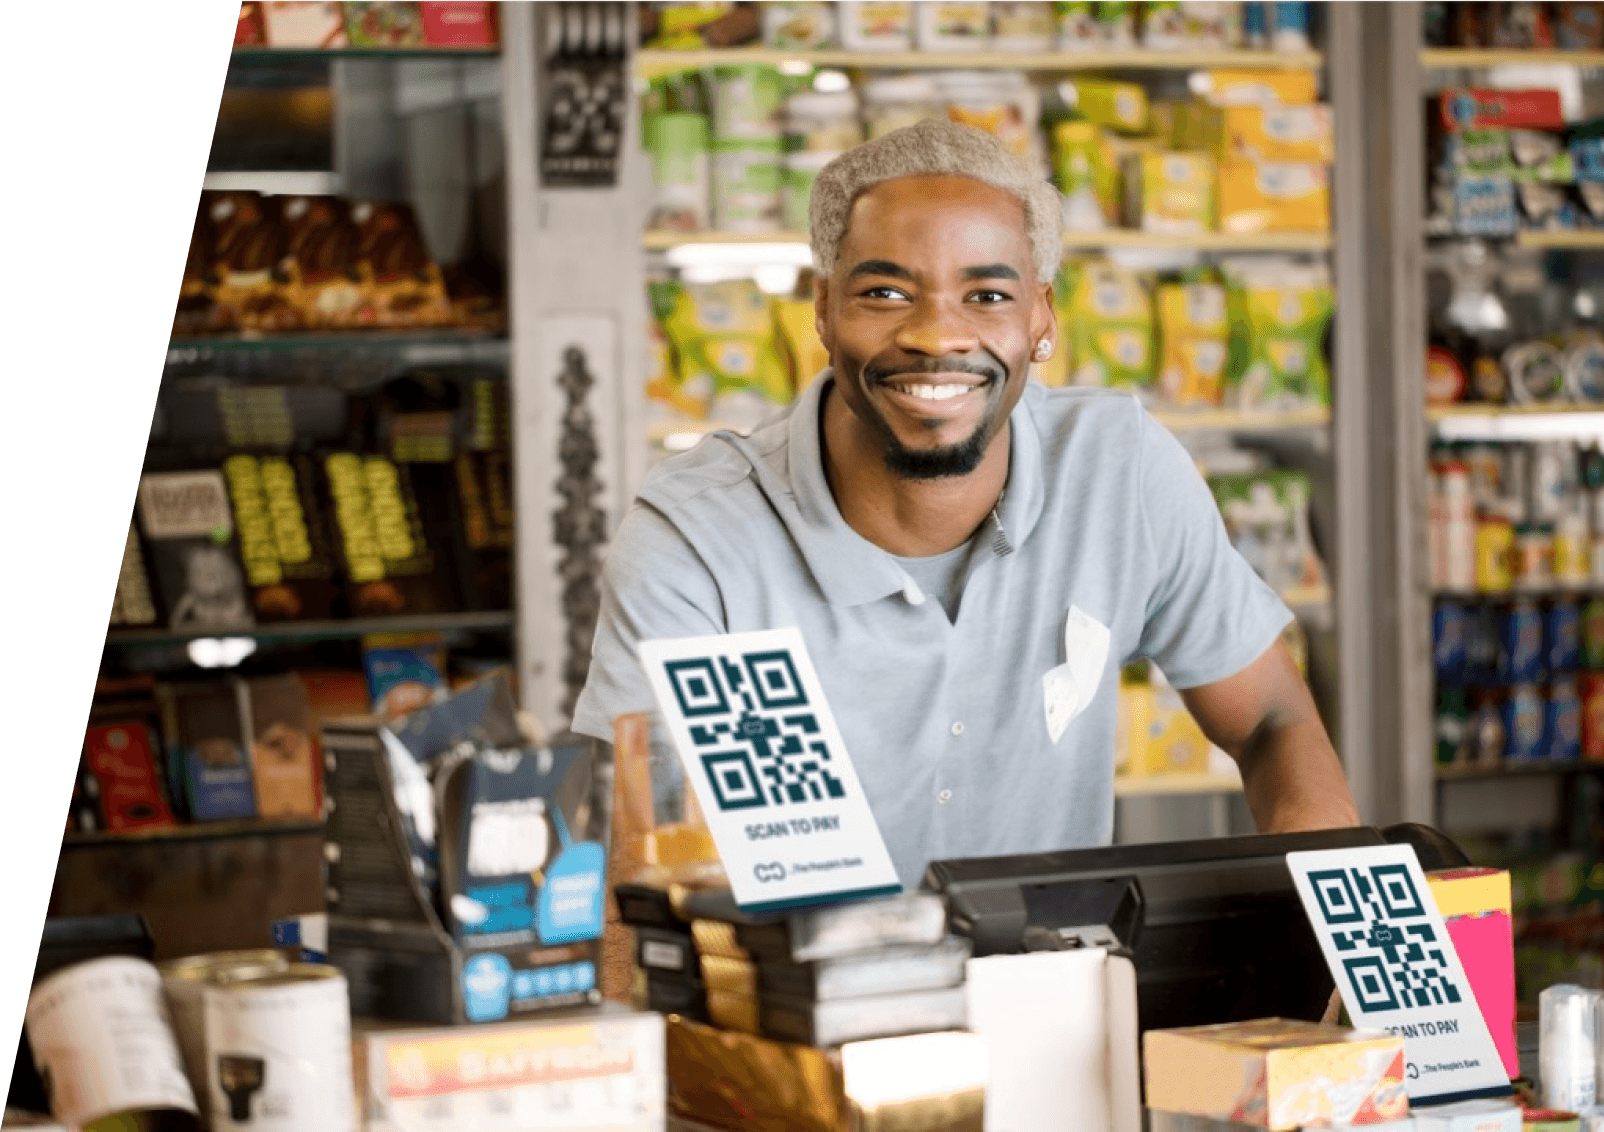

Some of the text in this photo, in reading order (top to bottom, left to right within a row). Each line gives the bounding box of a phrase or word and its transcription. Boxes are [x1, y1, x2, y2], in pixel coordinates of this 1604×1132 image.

[745, 815, 839, 840] SCAN TO PAY
[1418, 1022, 1435, 1036] TO
[1436, 1019, 1459, 1034] PAY
[1463, 1058, 1480, 1068] Bank
